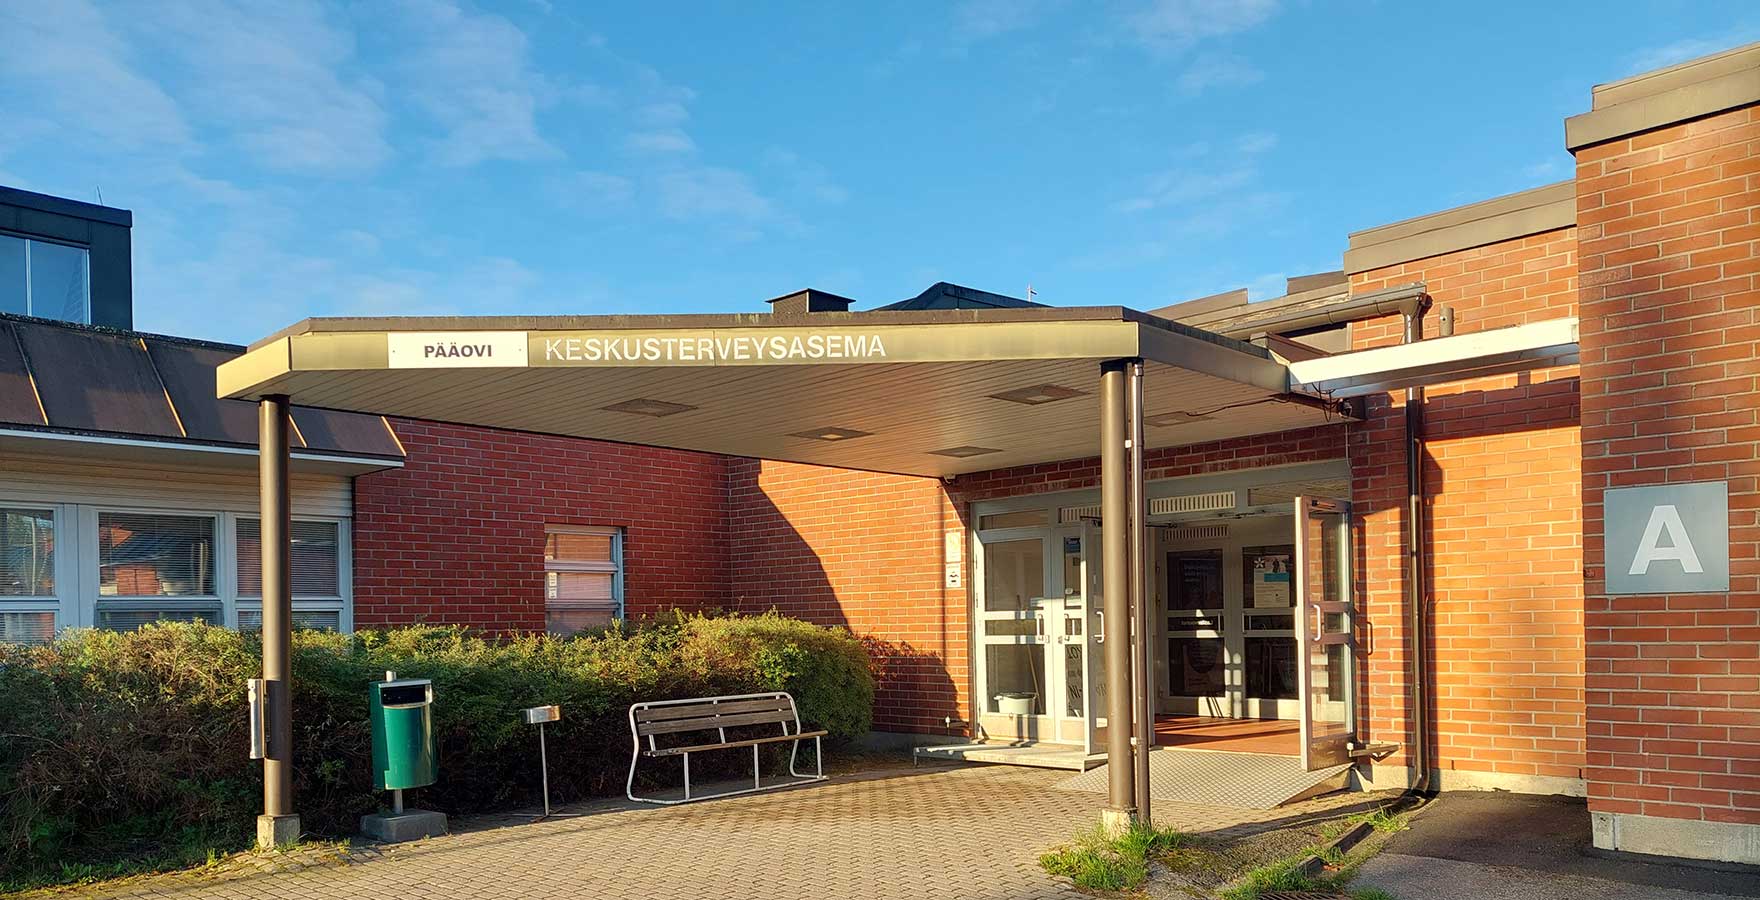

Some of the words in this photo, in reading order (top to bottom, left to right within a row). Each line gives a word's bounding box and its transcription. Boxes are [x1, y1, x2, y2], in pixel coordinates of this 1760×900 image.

[424, 342, 492, 358] PÄÄOVI
[545, 335, 887, 361] KESKUSTERVEYSASEMA
[1628, 504, 1704, 575] A
